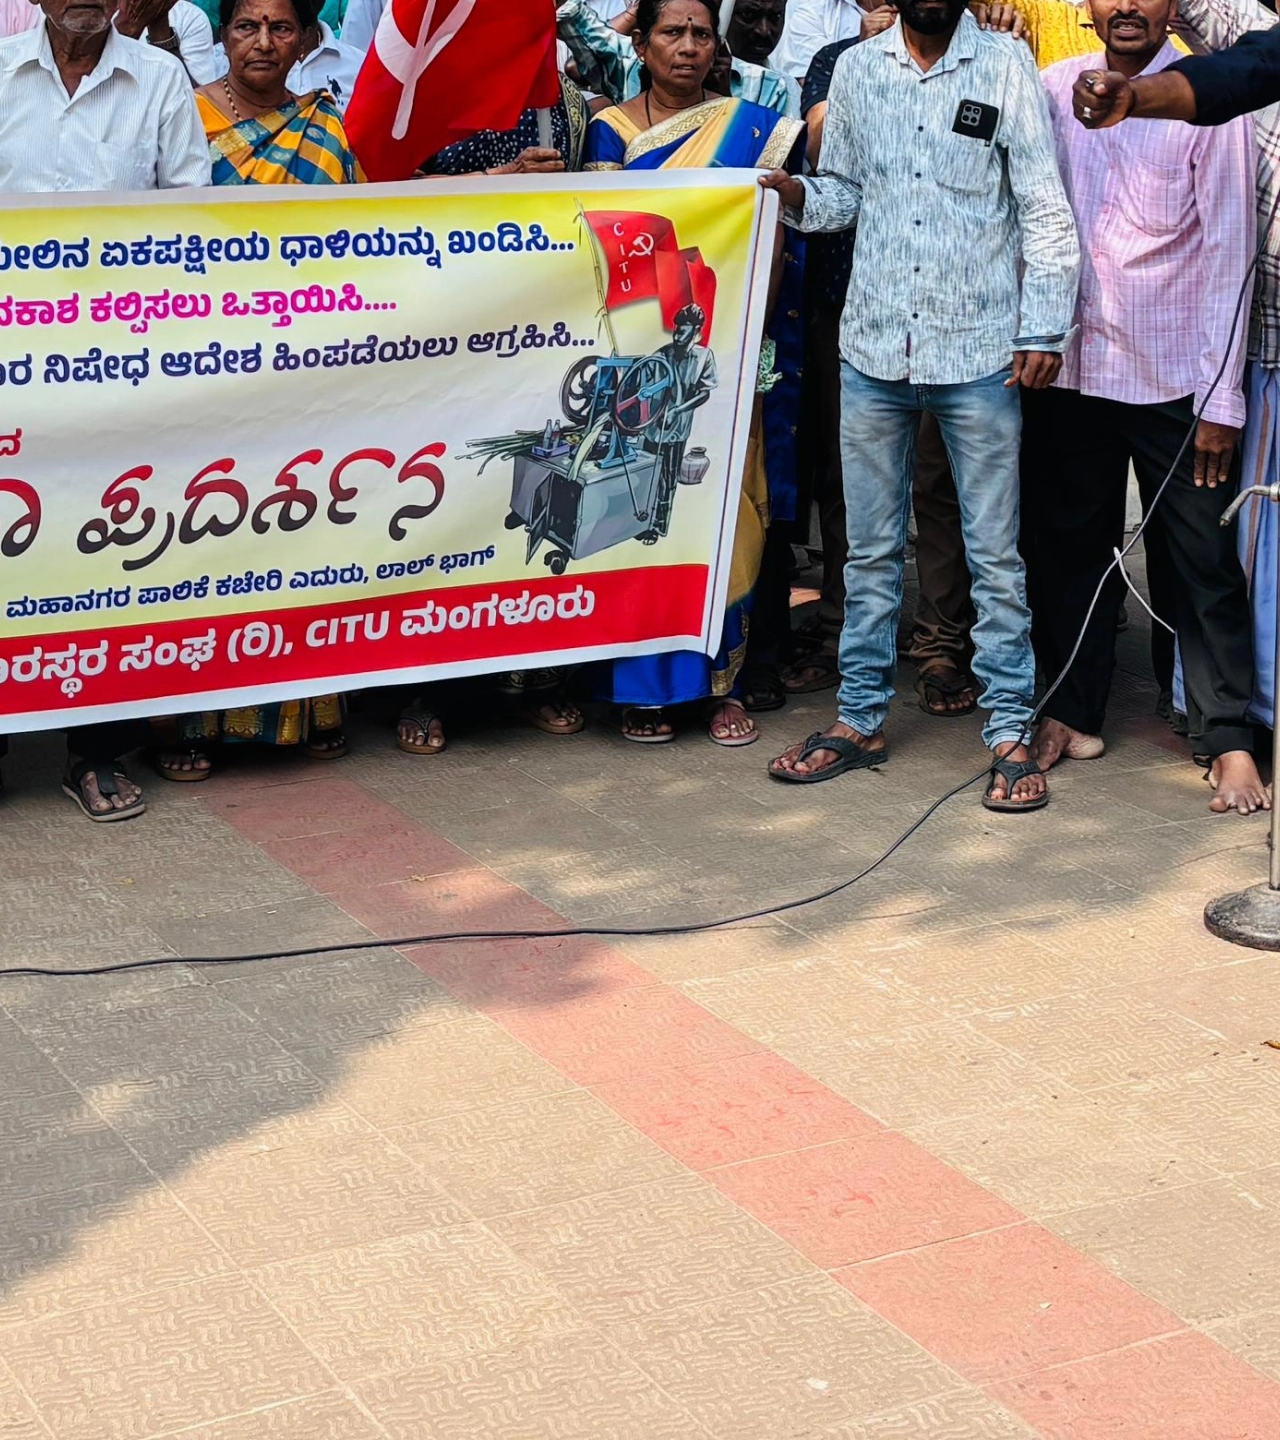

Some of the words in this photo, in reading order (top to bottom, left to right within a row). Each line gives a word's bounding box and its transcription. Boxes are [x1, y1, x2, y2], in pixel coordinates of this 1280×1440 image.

[100, 231, 270, 274] ಏಕಪಕ್ಷೀಯ
[280, 226, 442, 268] ಧಾಳಿಯನ್ನು
[448, 222, 574, 253] ಖಂಡಿಸಿ...
[90, 288, 211, 333] ಕಲ್ಪಿಸಲು
[43, 347, 149, 386] ನಿಷೇಧ
[161, 341, 262, 377] ಆದೇಶ
[272, 334, 457, 371] ಹಿಂಪಡೆಯಲು
[467, 322, 595, 358] ಆಗ್ರಹಿಸಿ...
[76, 441, 447, 571] ಪ್ರದರ್ಶನ
[6, 586, 131, 620] ಮಹಾನಗರ
[137, 575, 210, 606] ಪಾಲಿಕೆ
[215, 569, 282, 597] ಕಚೇರಿ
[289, 563, 369, 590] ಎದುರು,
[376, 553, 434, 580] ಲಾಲ್
[439, 545, 495, 575] ಭಾಗ್
[119, 627, 216, 672] ಸಂಘ
[305, 611, 390, 649] CITU
[400, 583, 596, 636] ಮಂಗಳೂರು
